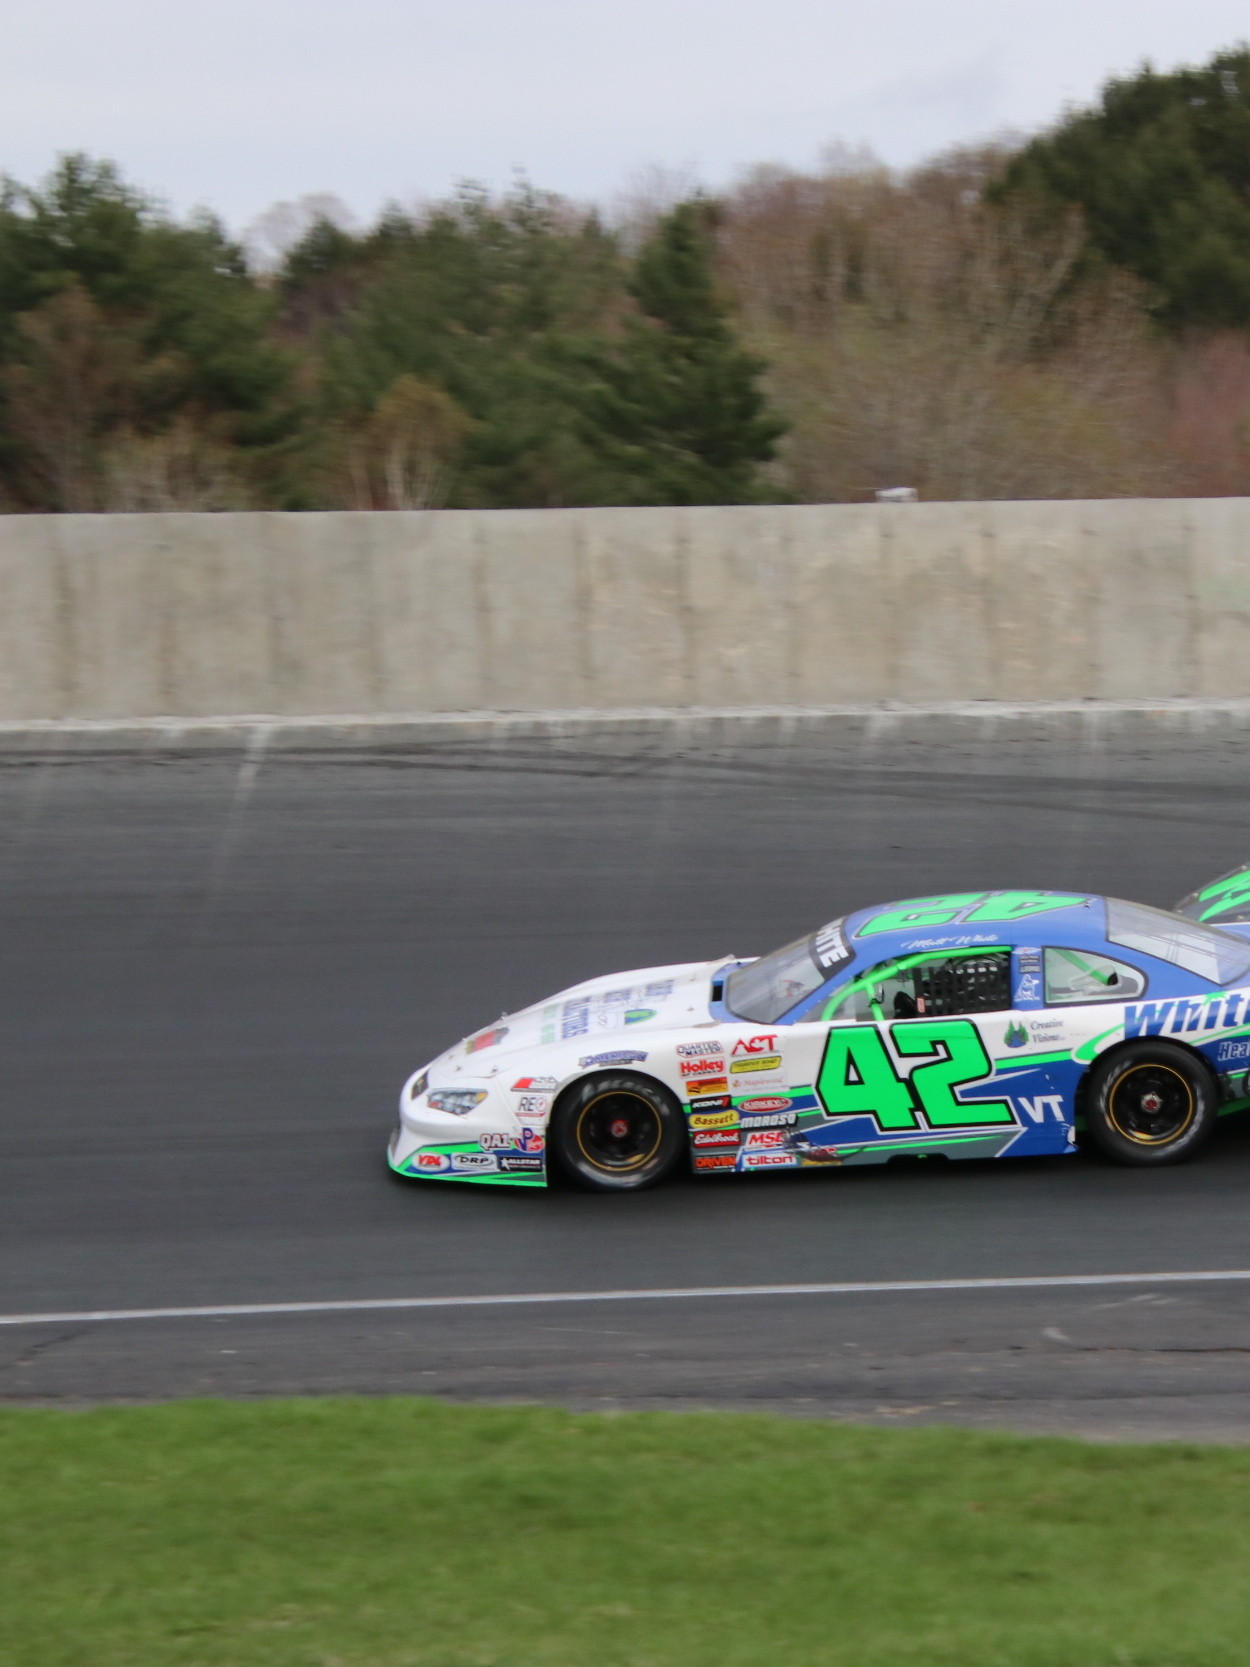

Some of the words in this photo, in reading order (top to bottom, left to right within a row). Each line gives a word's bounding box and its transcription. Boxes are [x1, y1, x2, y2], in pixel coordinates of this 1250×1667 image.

[731, 1034, 778, 1056] ACT
[680, 1058, 724, 1074] Holley
[815, 1018, 1019, 1133] 42
[692, 1100, 723, 1108] KONI
[1018, 1094, 1066, 1124] VT
[693, 1112, 734, 1126] Bassett
[741, 1113, 797, 1128] MOROSO
[480, 1133, 511, 1151] QA1
[460, 1155, 490, 1165] DRP
[695, 1155, 736, 1169] DRIVEN
[745, 1154, 793, 1165] tilton
